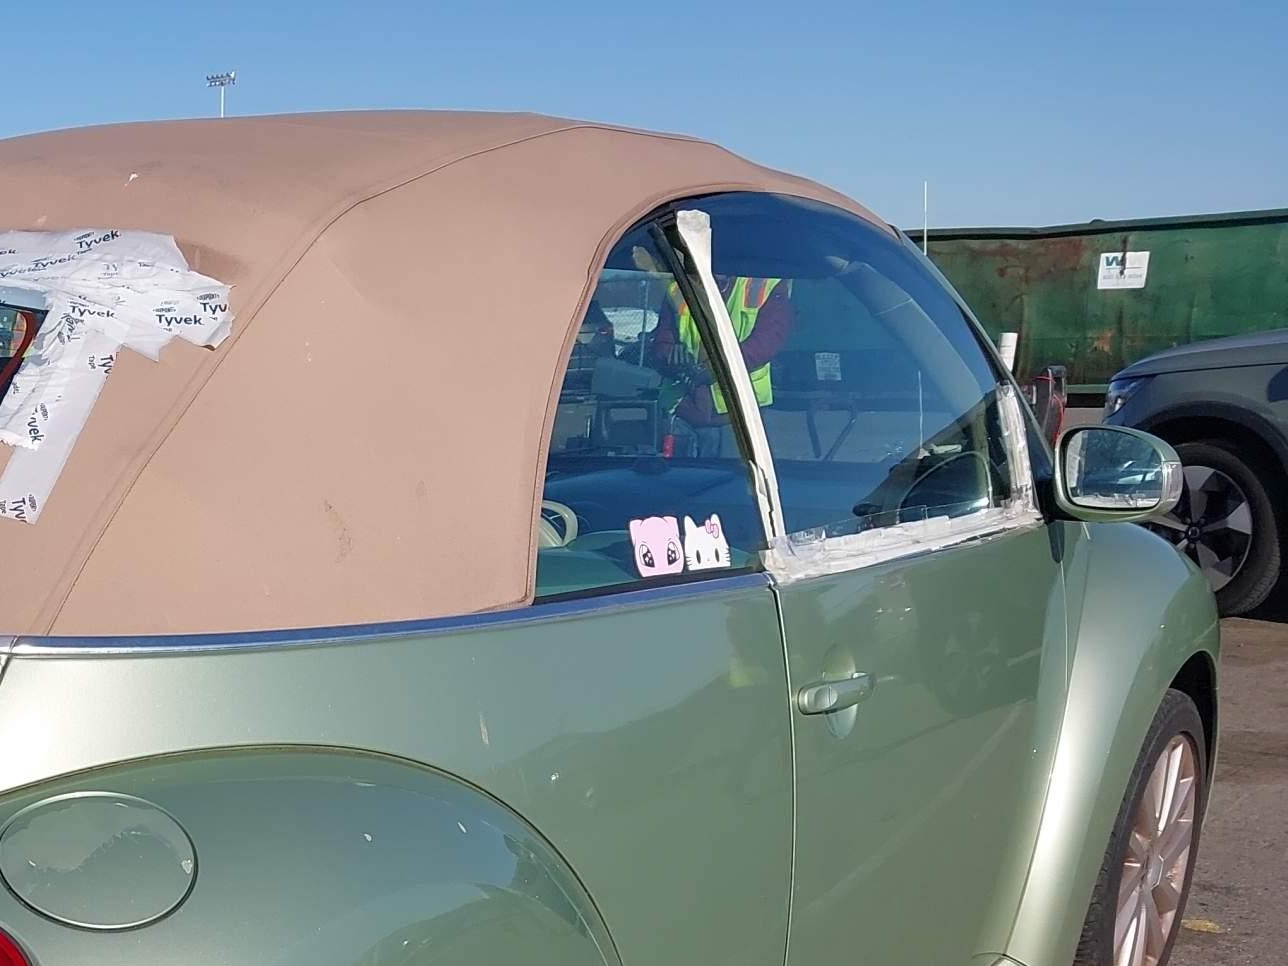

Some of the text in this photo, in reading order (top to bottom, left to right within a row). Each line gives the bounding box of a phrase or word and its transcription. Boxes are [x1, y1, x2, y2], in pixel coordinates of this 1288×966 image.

[76, 230, 120, 248] Tyvek
[32, 254, 76, 269] Tyvek
[70, 305, 116, 318] Tyvek
[155, 314, 204, 327] Tyvek
[27, 410, 45, 442] vek
